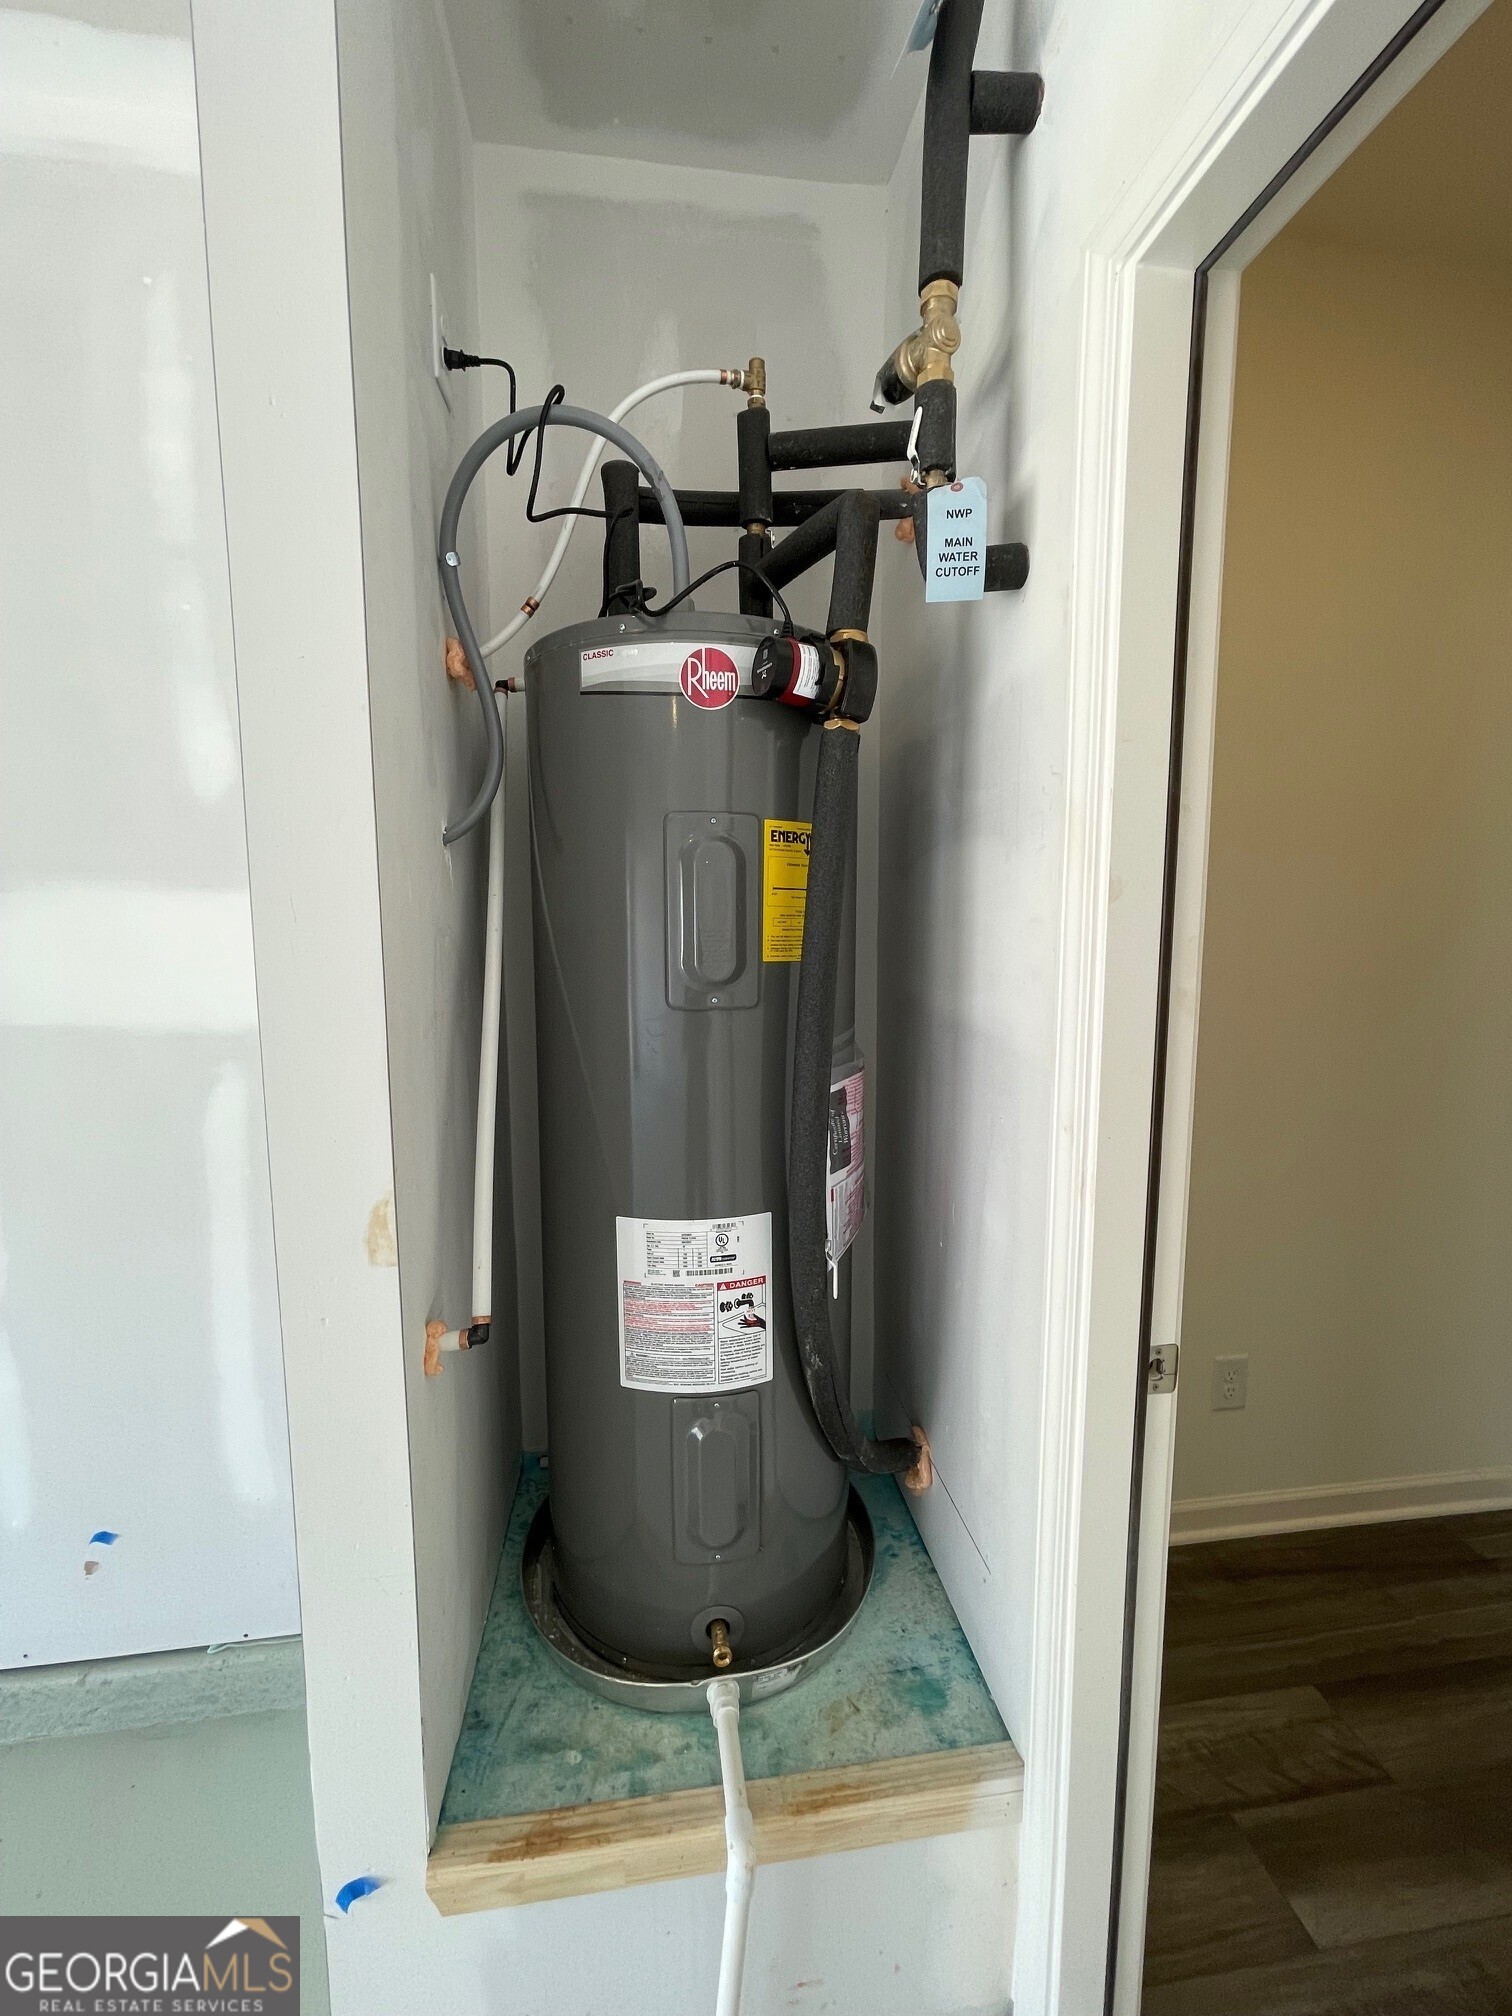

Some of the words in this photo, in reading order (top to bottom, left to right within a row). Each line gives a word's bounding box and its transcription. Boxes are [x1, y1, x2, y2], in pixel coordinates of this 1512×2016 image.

[946, 508, 973, 519] NWP
[944, 537, 973, 548] MAIN
[938, 551, 978, 563] WATER
[935, 566, 980, 577] CUTOFF
[582, 649, 614, 661] CLASSIC
[687, 648, 736, 699] Rheem
[770, 829, 811, 845] ENERGY
[729, 1277, 765, 1289] DANGER
